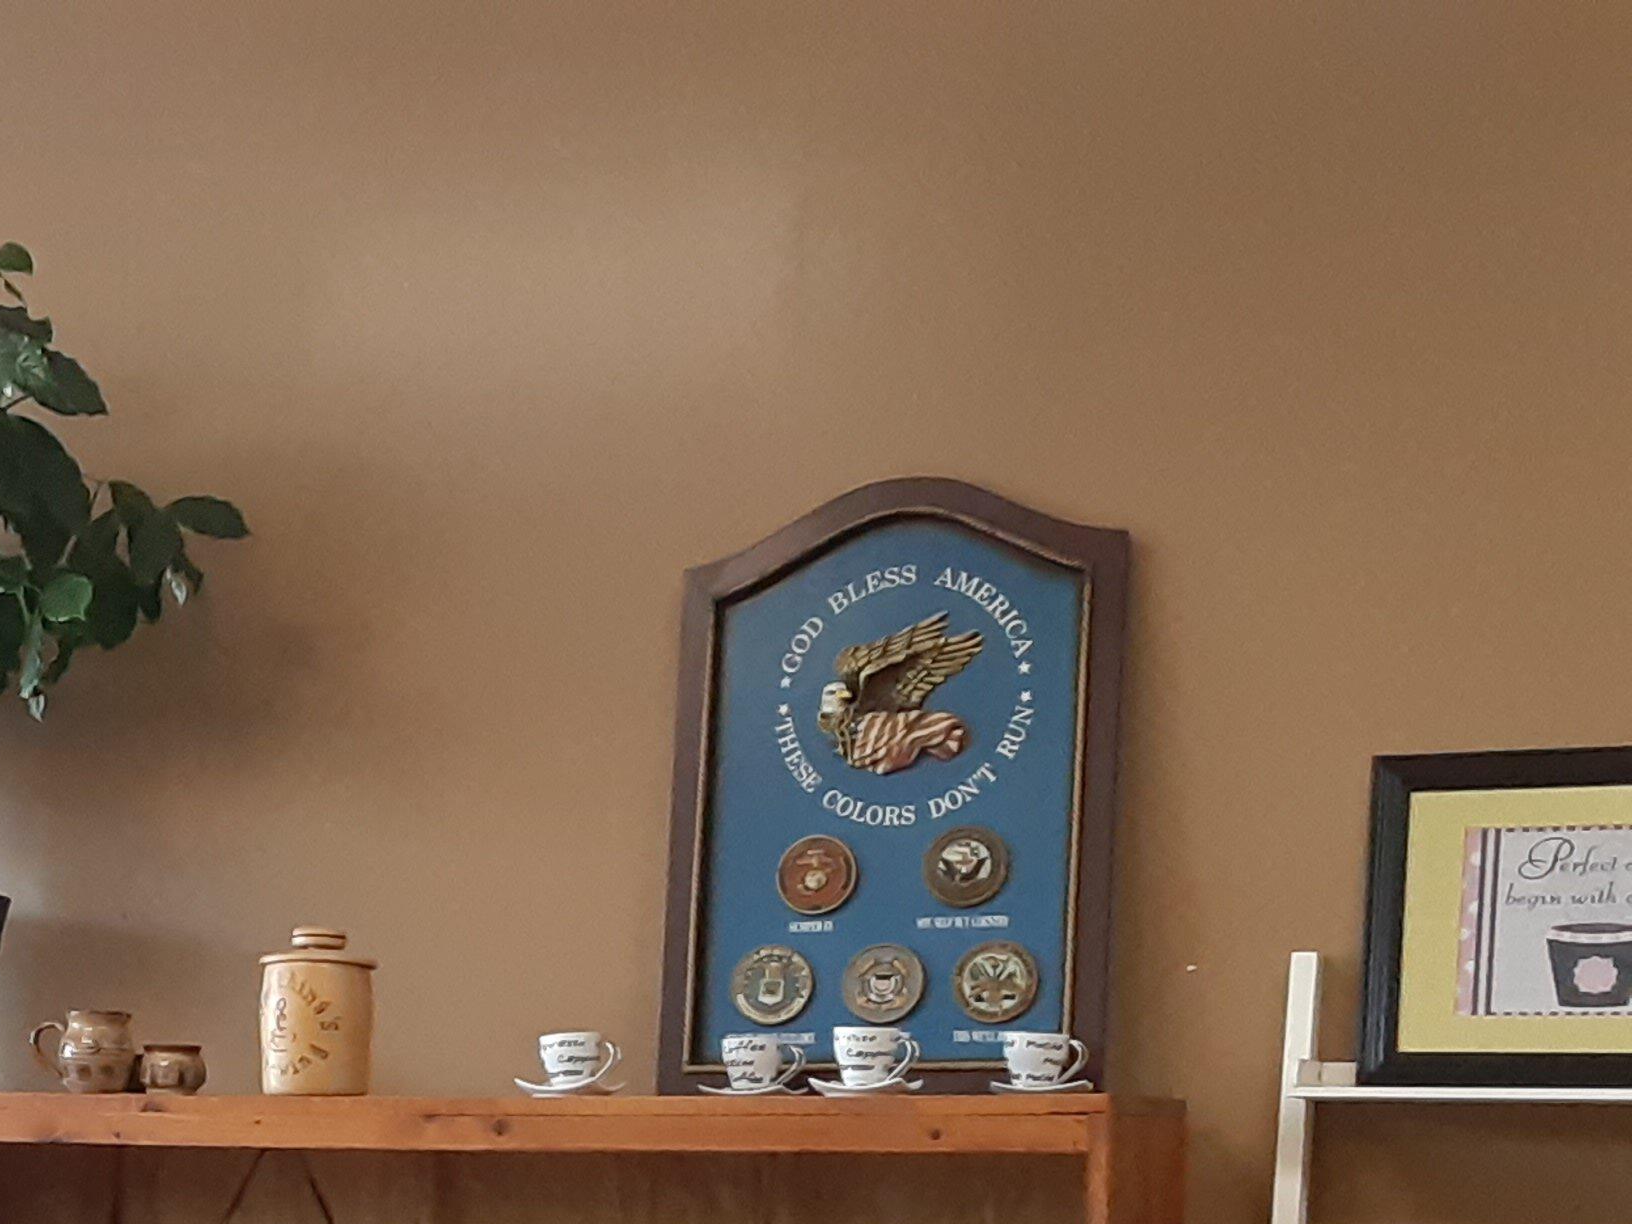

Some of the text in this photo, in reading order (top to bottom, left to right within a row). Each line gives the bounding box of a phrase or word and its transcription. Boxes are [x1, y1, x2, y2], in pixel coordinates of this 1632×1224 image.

[782, 564, 1034, 673] GOD BLESS AMERICA
[775, 704, 1035, 826] THESE COLORS DON'T RUN
[1505, 882, 1561, 910] begin
[1570, 881, 1617, 905] with
[1519, 836, 1617, 880] Perfect
